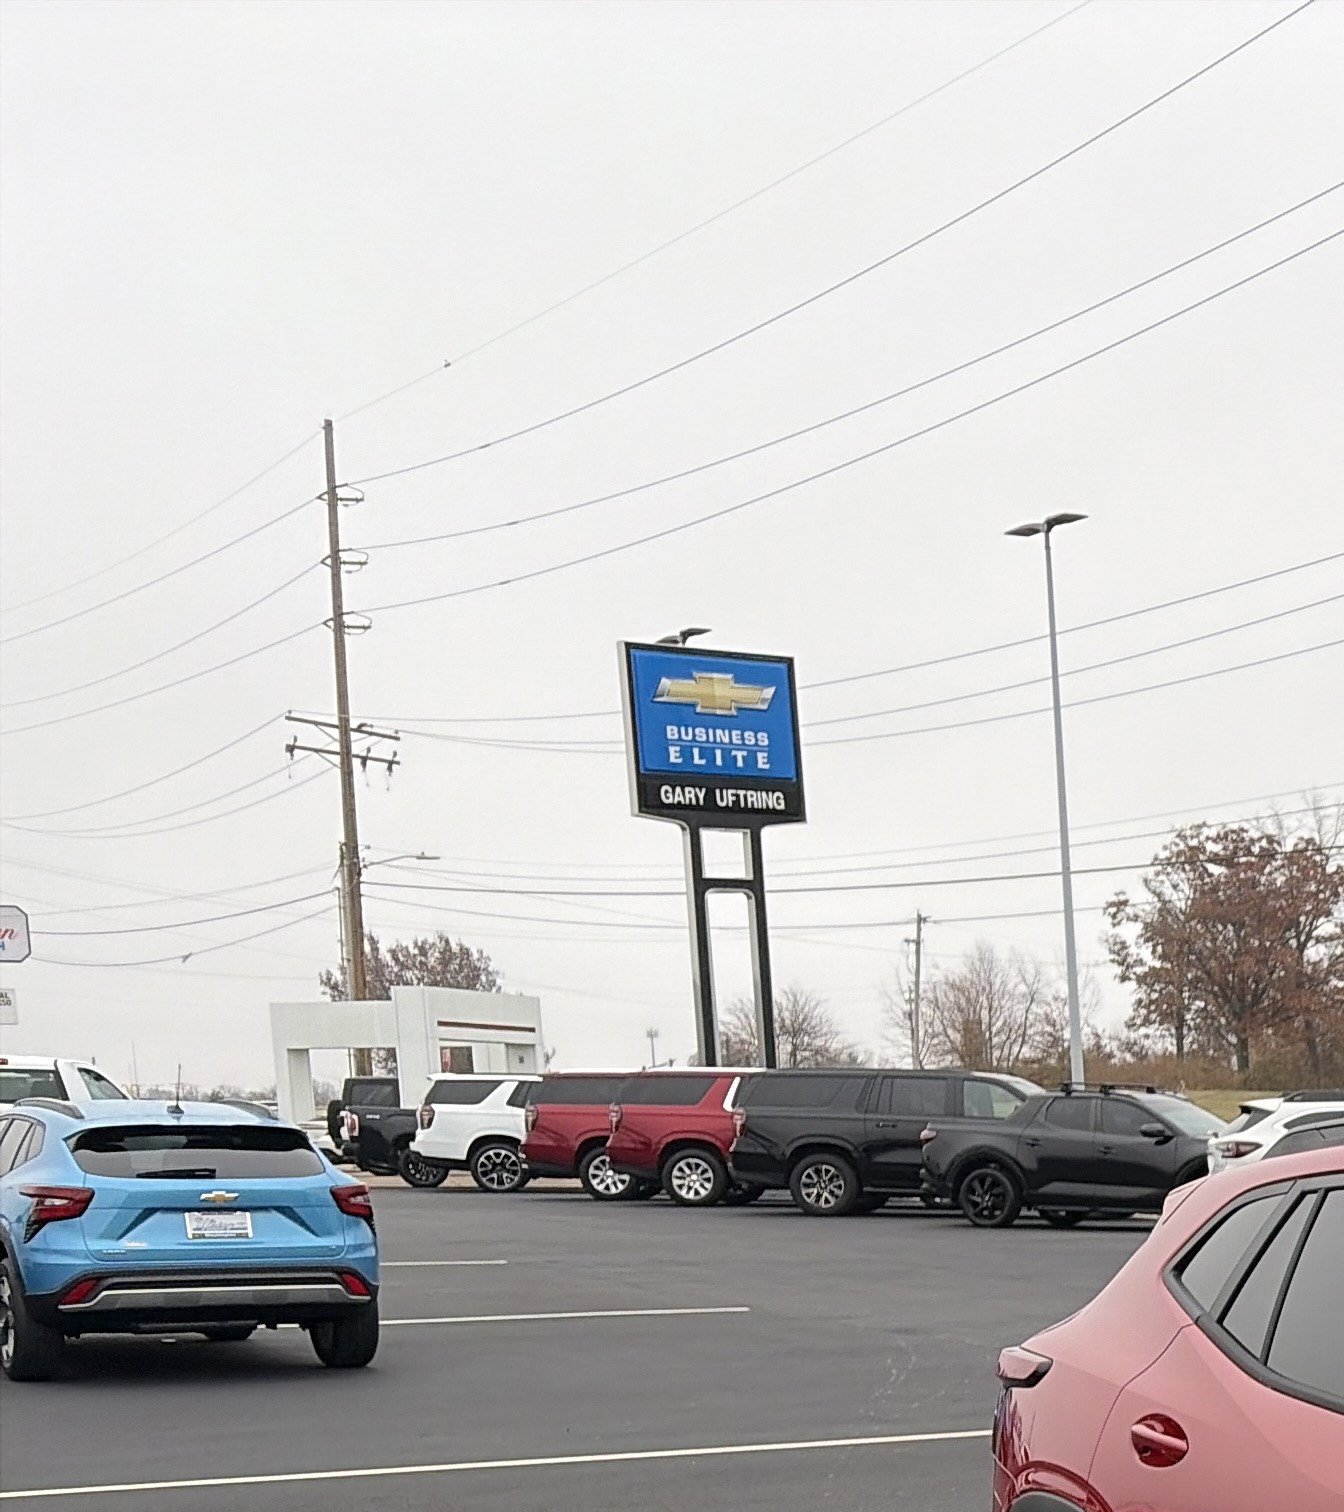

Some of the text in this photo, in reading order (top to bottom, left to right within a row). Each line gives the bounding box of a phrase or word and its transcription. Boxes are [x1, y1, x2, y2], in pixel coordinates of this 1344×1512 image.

[666, 724, 769, 746] BUSINESS
[668, 746, 771, 769] ELITE
[660, 784, 786, 810] GARY UFTRING
